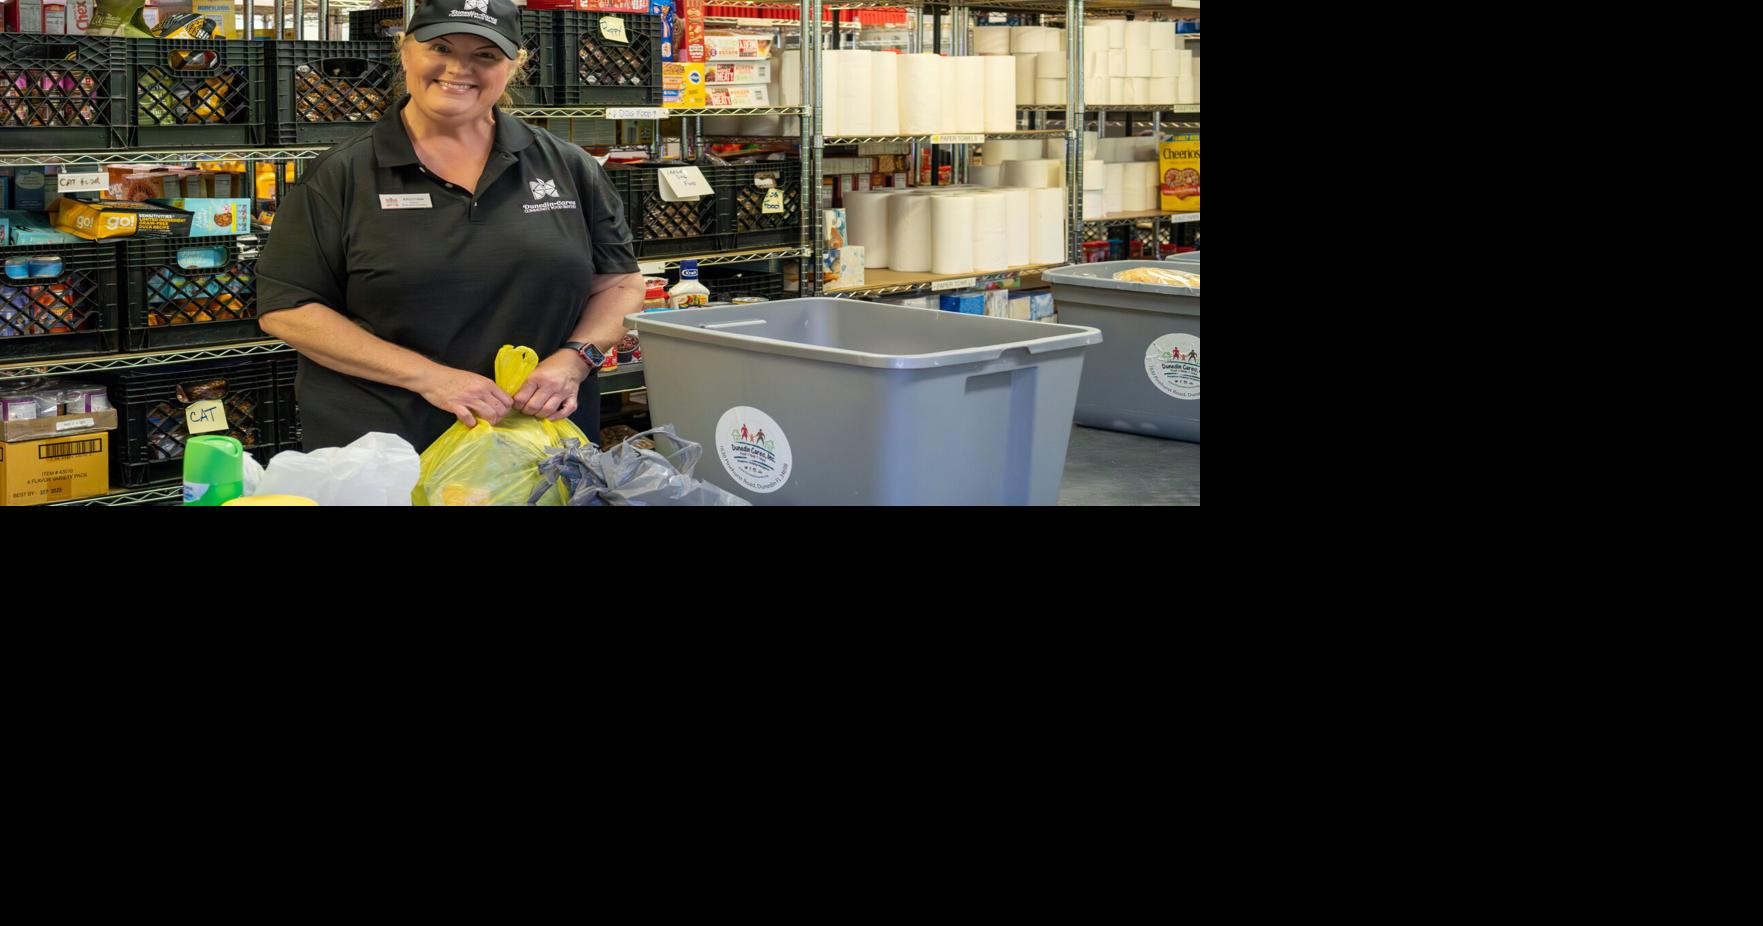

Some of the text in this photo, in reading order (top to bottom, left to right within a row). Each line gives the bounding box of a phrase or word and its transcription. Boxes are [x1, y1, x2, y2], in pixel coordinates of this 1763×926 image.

[77, 215, 94, 229] go!
[107, 215, 135, 231] go!
[189, 406, 217, 423] CAT
[731, 444, 750, 453] Dunedin
